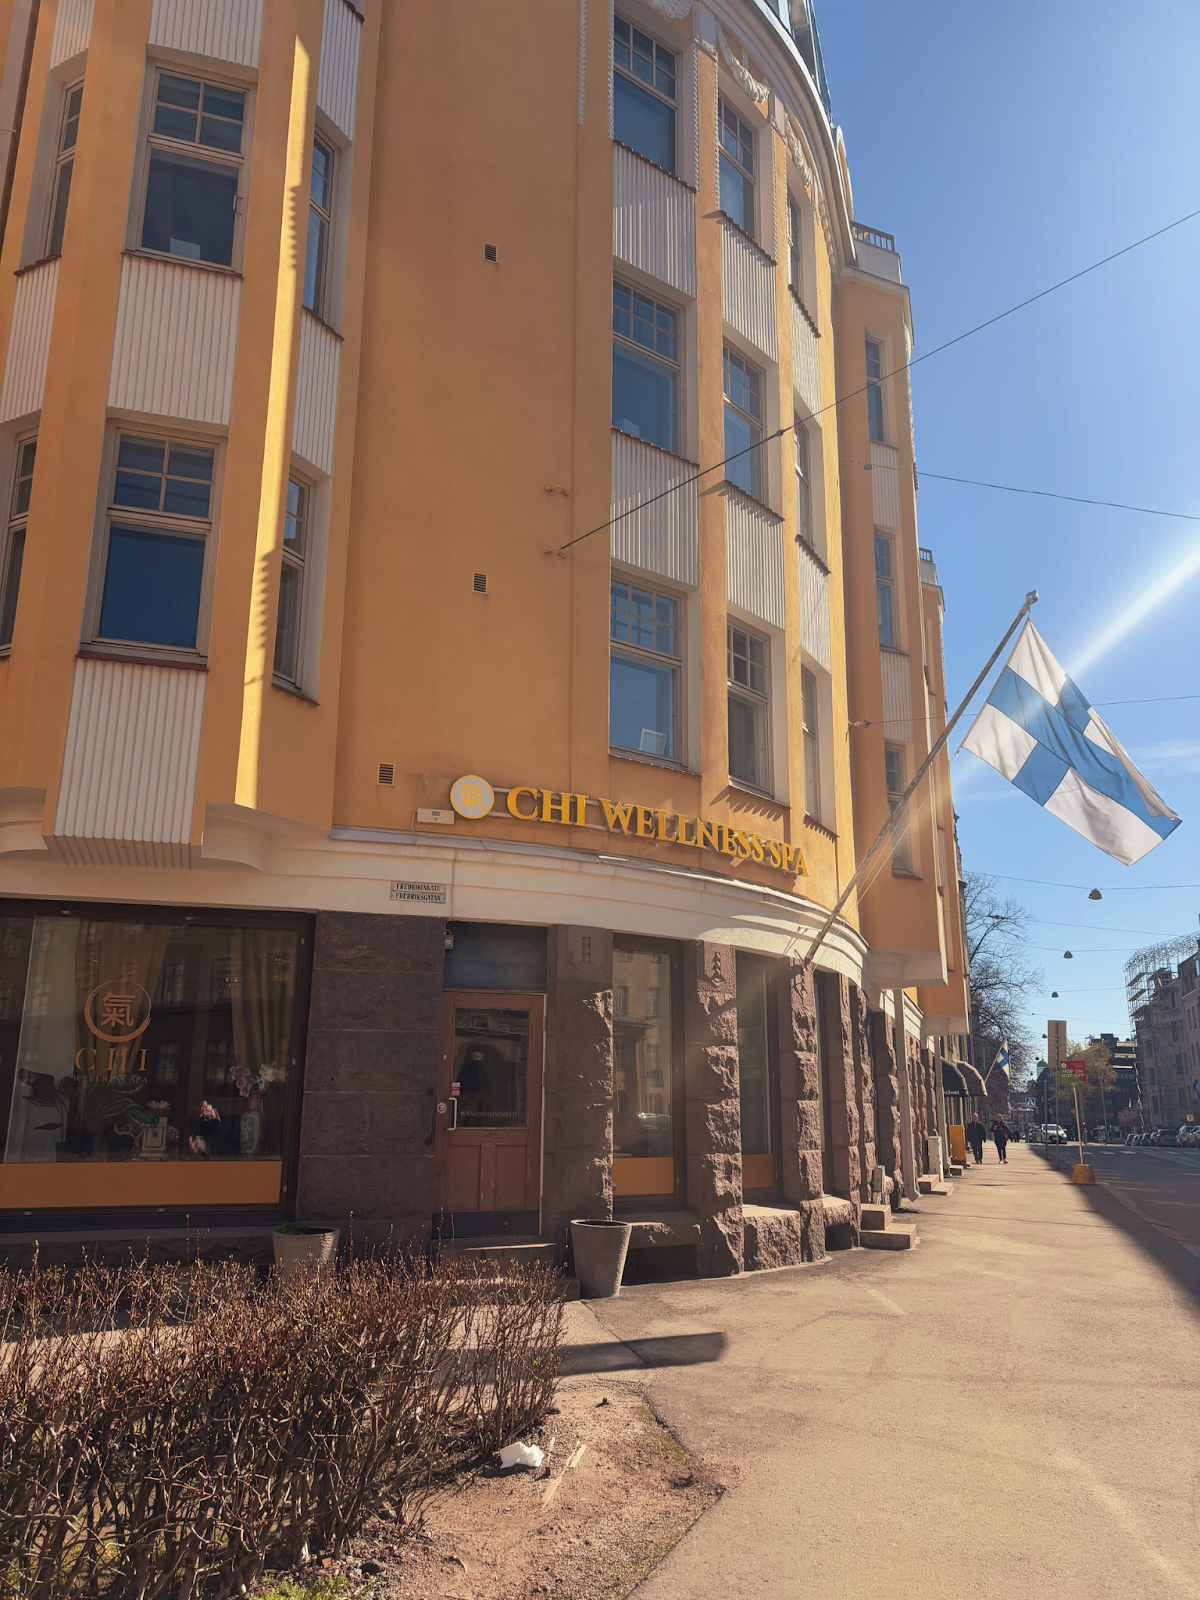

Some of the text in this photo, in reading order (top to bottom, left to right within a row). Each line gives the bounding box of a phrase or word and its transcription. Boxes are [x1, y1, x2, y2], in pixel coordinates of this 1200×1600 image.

[459, 782, 486, 811] 氣
[507, 786, 810, 877] CHI WELLNESS SPA
[395, 892, 442, 902] FREDRIKSGATAN
[396, 882, 442, 892] FREDRIKINKATU
[100, 991, 136, 1028] 氣
[75, 1047, 149, 1072] CHI
[130, 1075, 148, 1084] SPA
